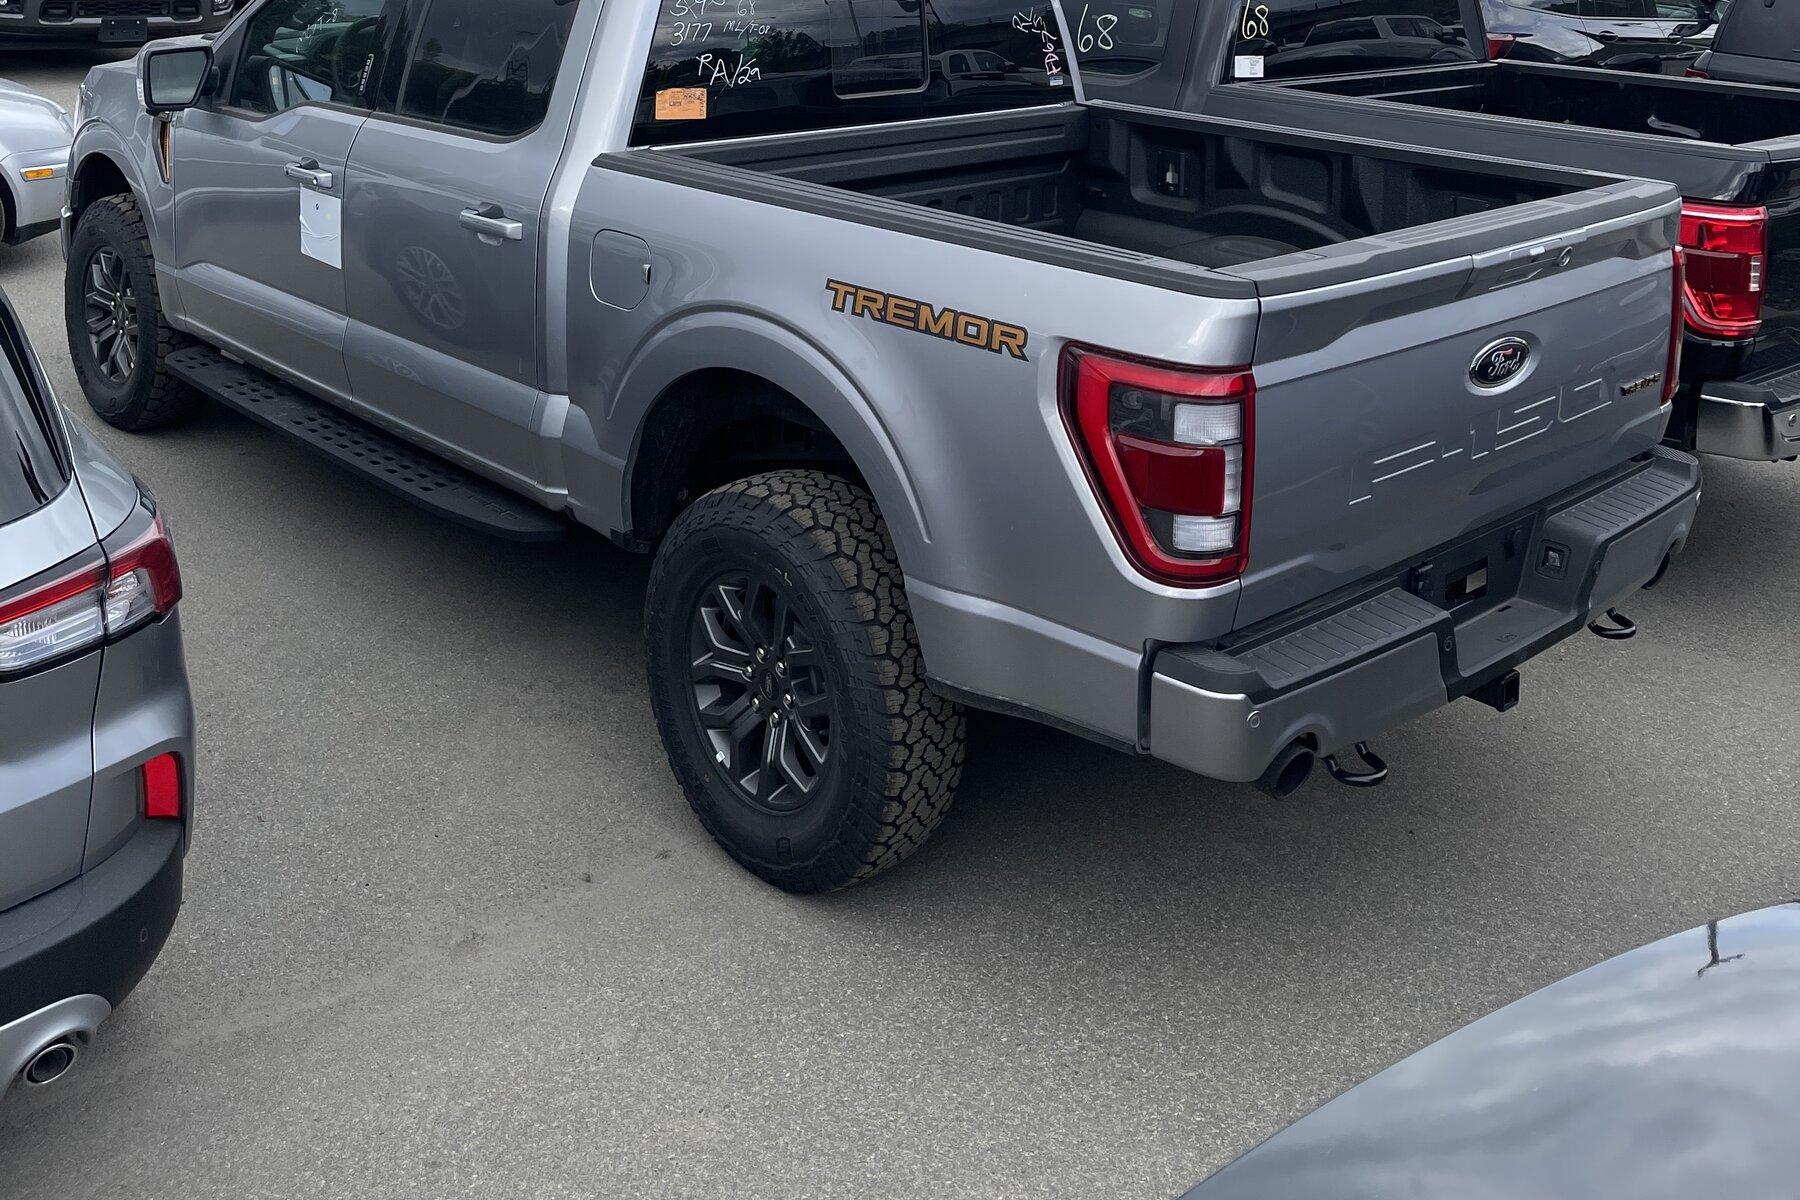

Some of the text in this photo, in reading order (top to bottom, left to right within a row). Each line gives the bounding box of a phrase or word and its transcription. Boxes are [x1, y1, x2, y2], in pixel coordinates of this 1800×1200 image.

[670, 21, 713, 47] 3177
[1077, 3, 1118, 53] 68
[825, 277, 1030, 362] TREMOR
[1487, 347, 1522, 377] Ford
[1347, 375, 1613, 506] F-150
